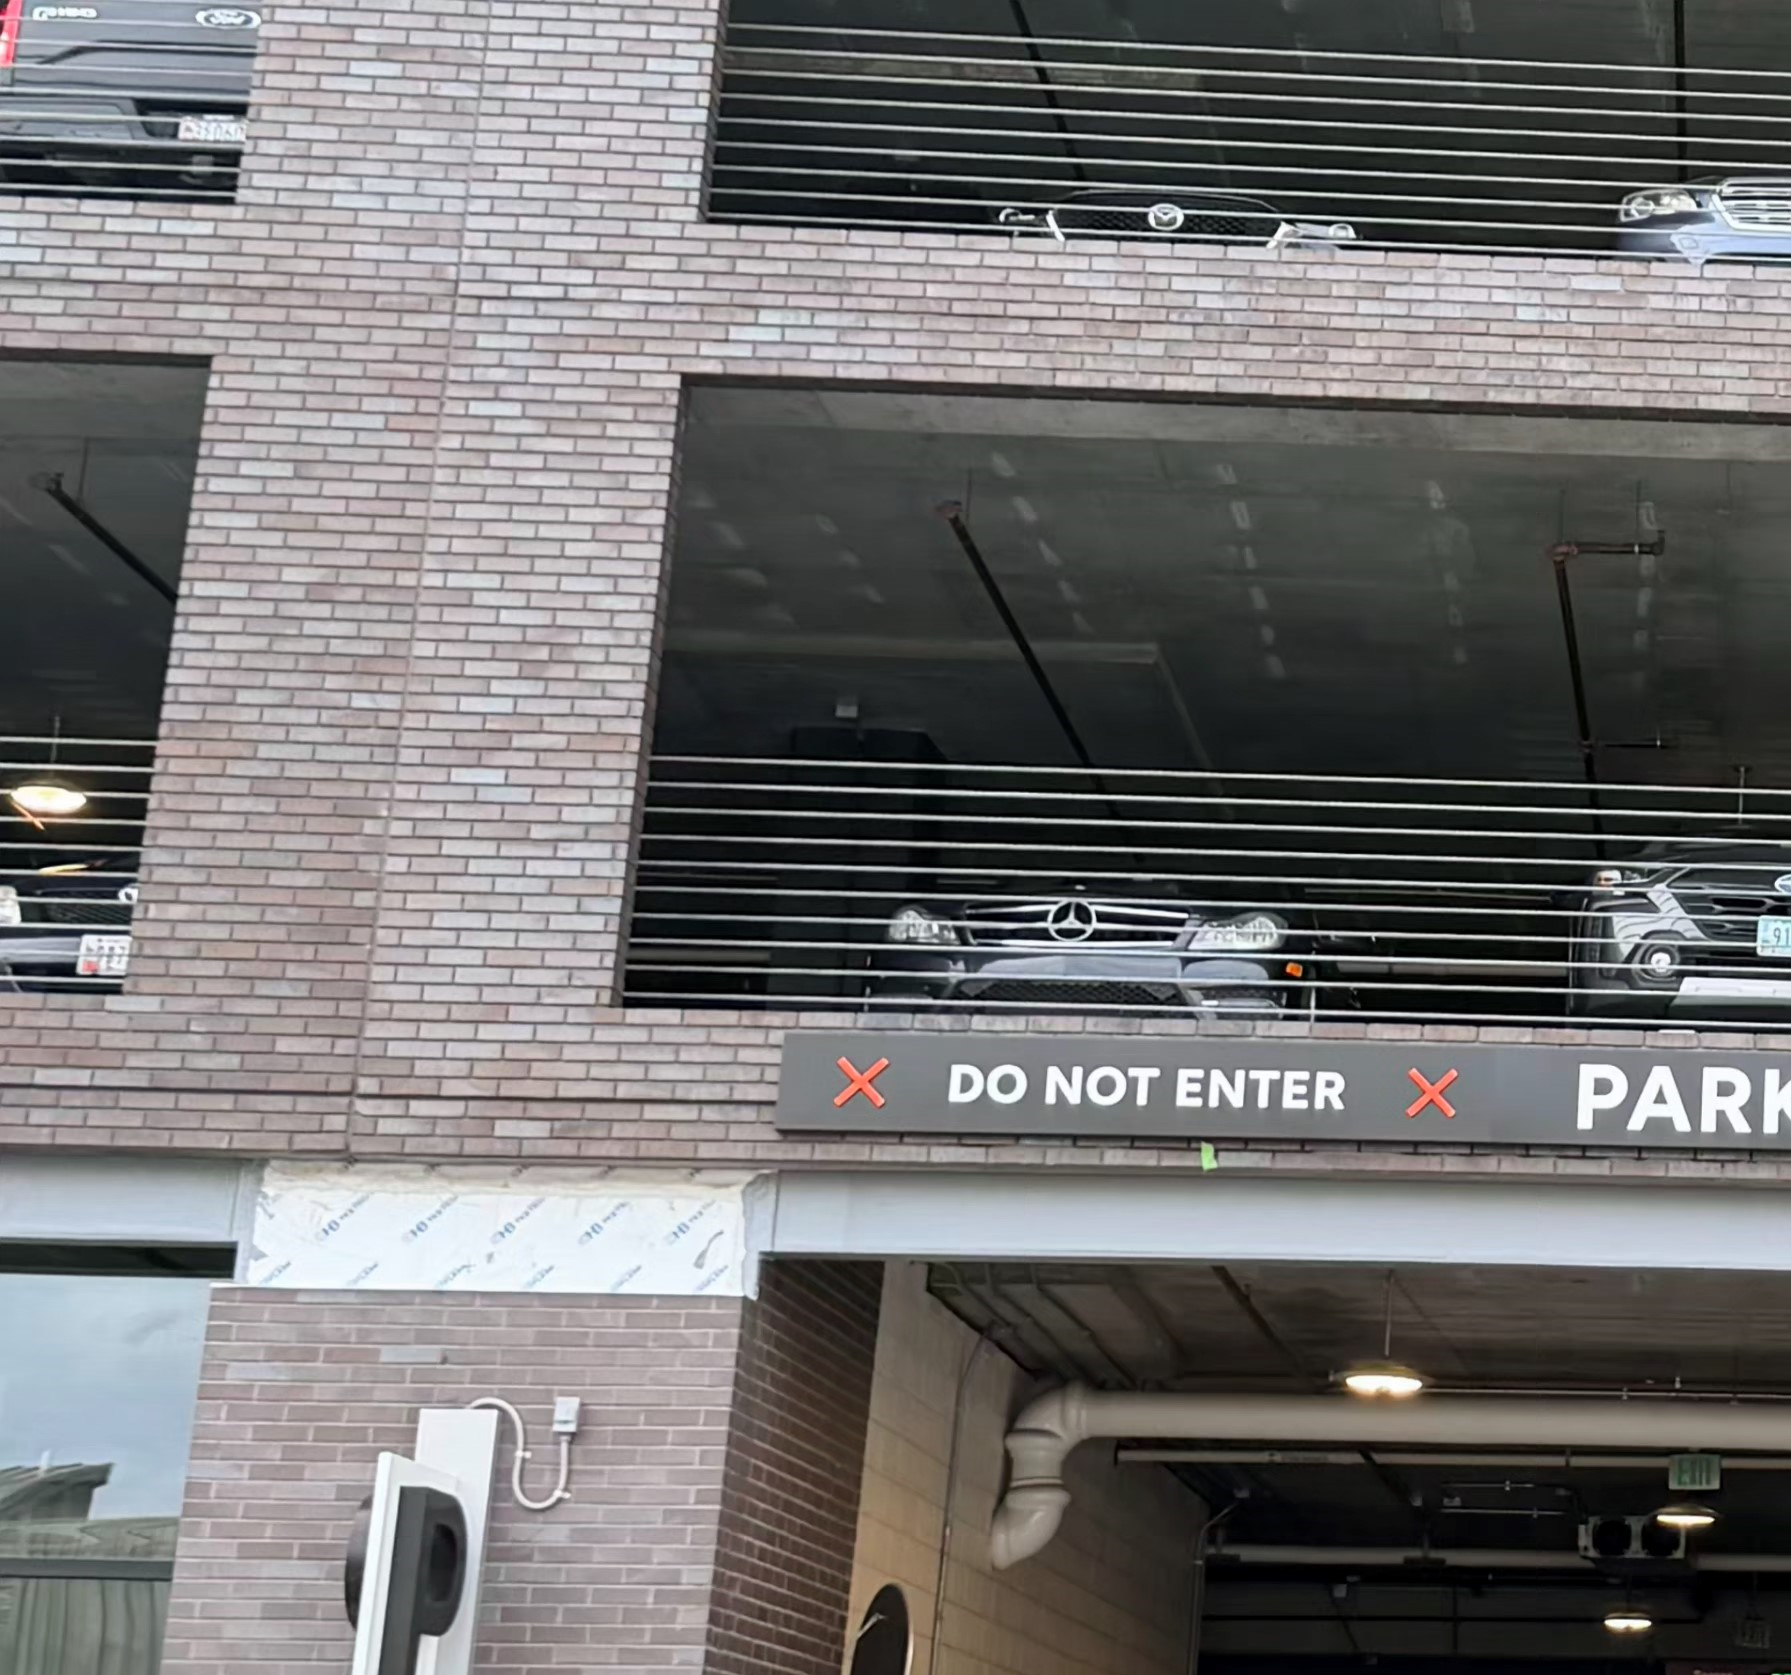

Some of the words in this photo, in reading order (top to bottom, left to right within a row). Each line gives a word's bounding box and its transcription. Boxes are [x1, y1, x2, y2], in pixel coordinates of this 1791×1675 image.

[947, 1063, 1029, 1106] DO
[1044, 1065, 1162, 1108] NOT
[1175, 1067, 1347, 1111] ENTER
